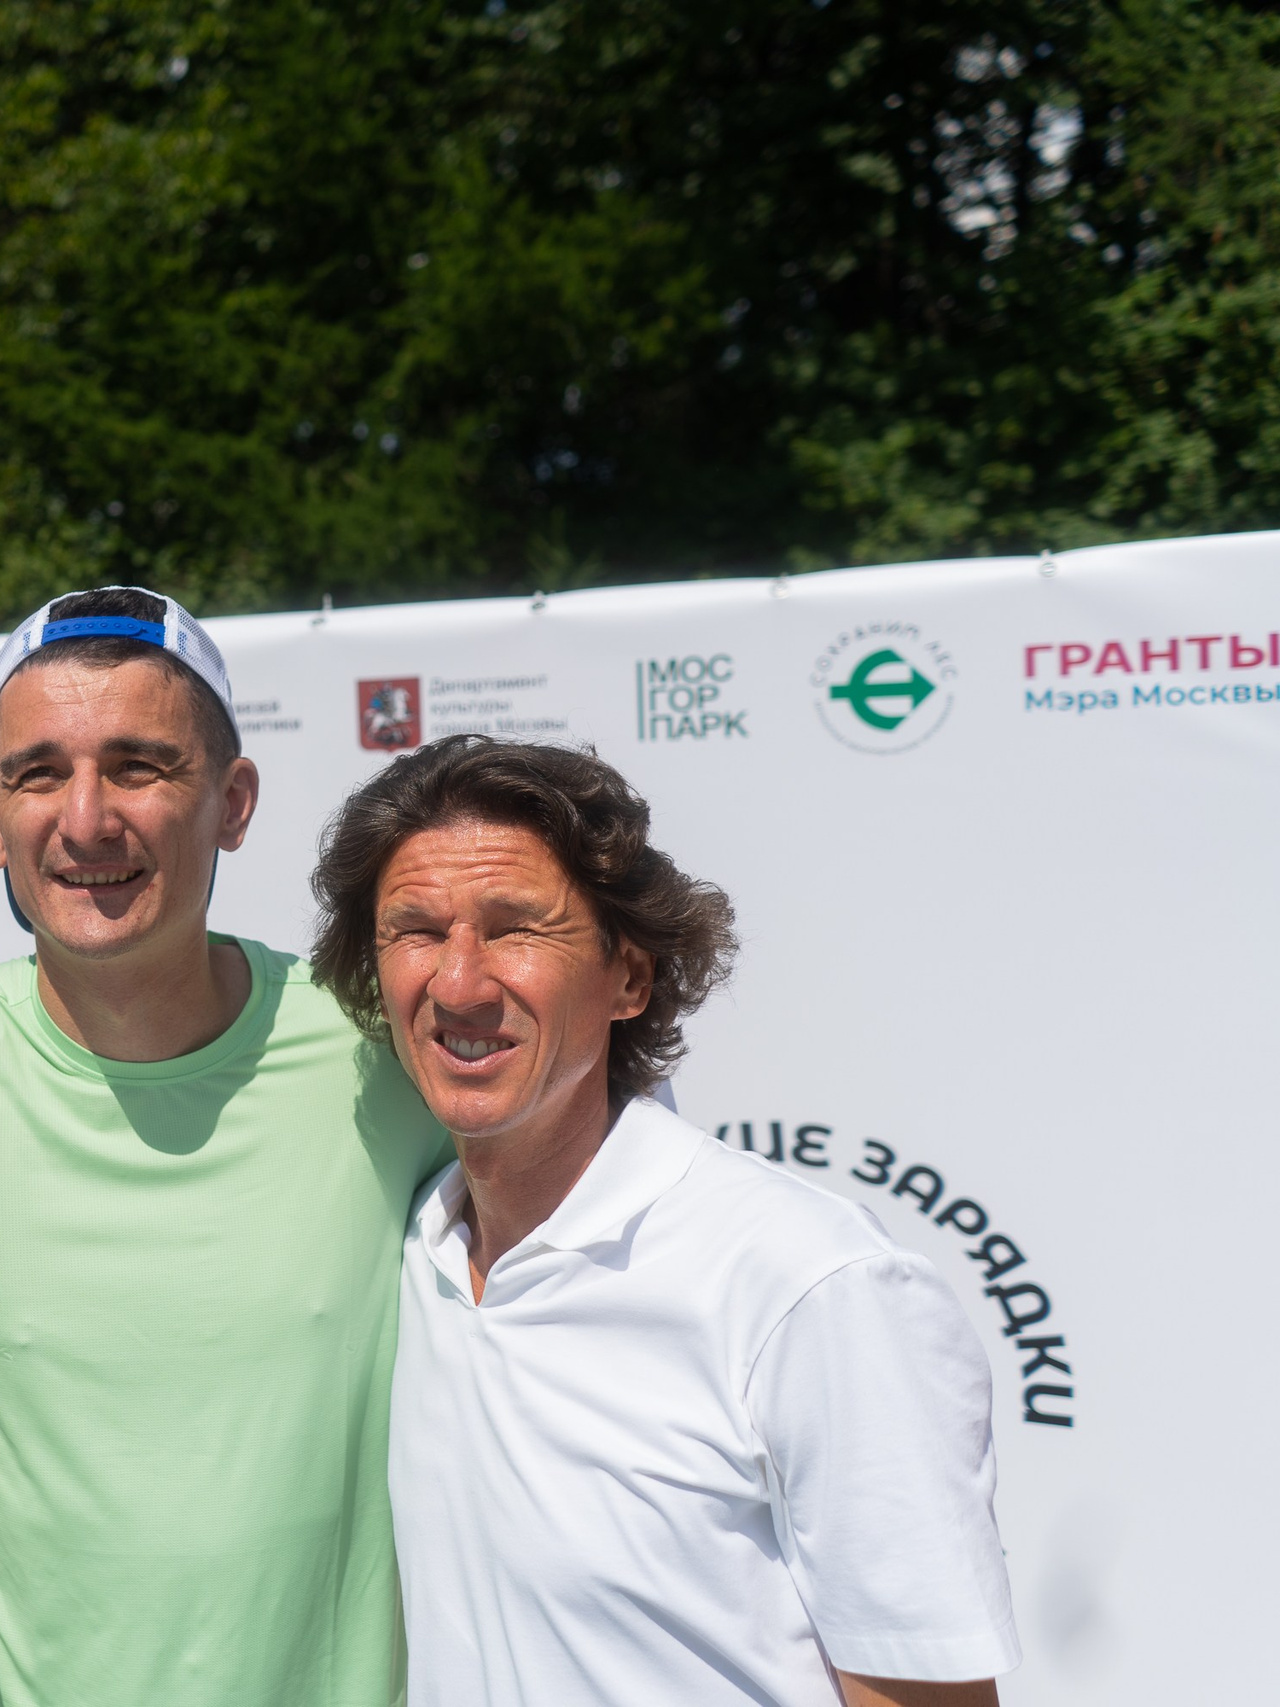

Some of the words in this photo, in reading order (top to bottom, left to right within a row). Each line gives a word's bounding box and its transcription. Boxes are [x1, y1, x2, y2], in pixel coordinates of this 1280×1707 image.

[647, 653, 735, 684] МОС
[1023, 632, 1280, 680] ГРАНТЫ
[429, 674, 549, 696] Департамент
[648, 683, 721, 712] ГОР
[1024, 687, 1120, 715] Мэра
[1132, 683, 1280, 707] Москвы
[648, 709, 750, 741] ПАРК
[718, 1119, 833, 1168] ИЕ
[850, 1138, 1074, 1428] ЗАРЯДКИ
